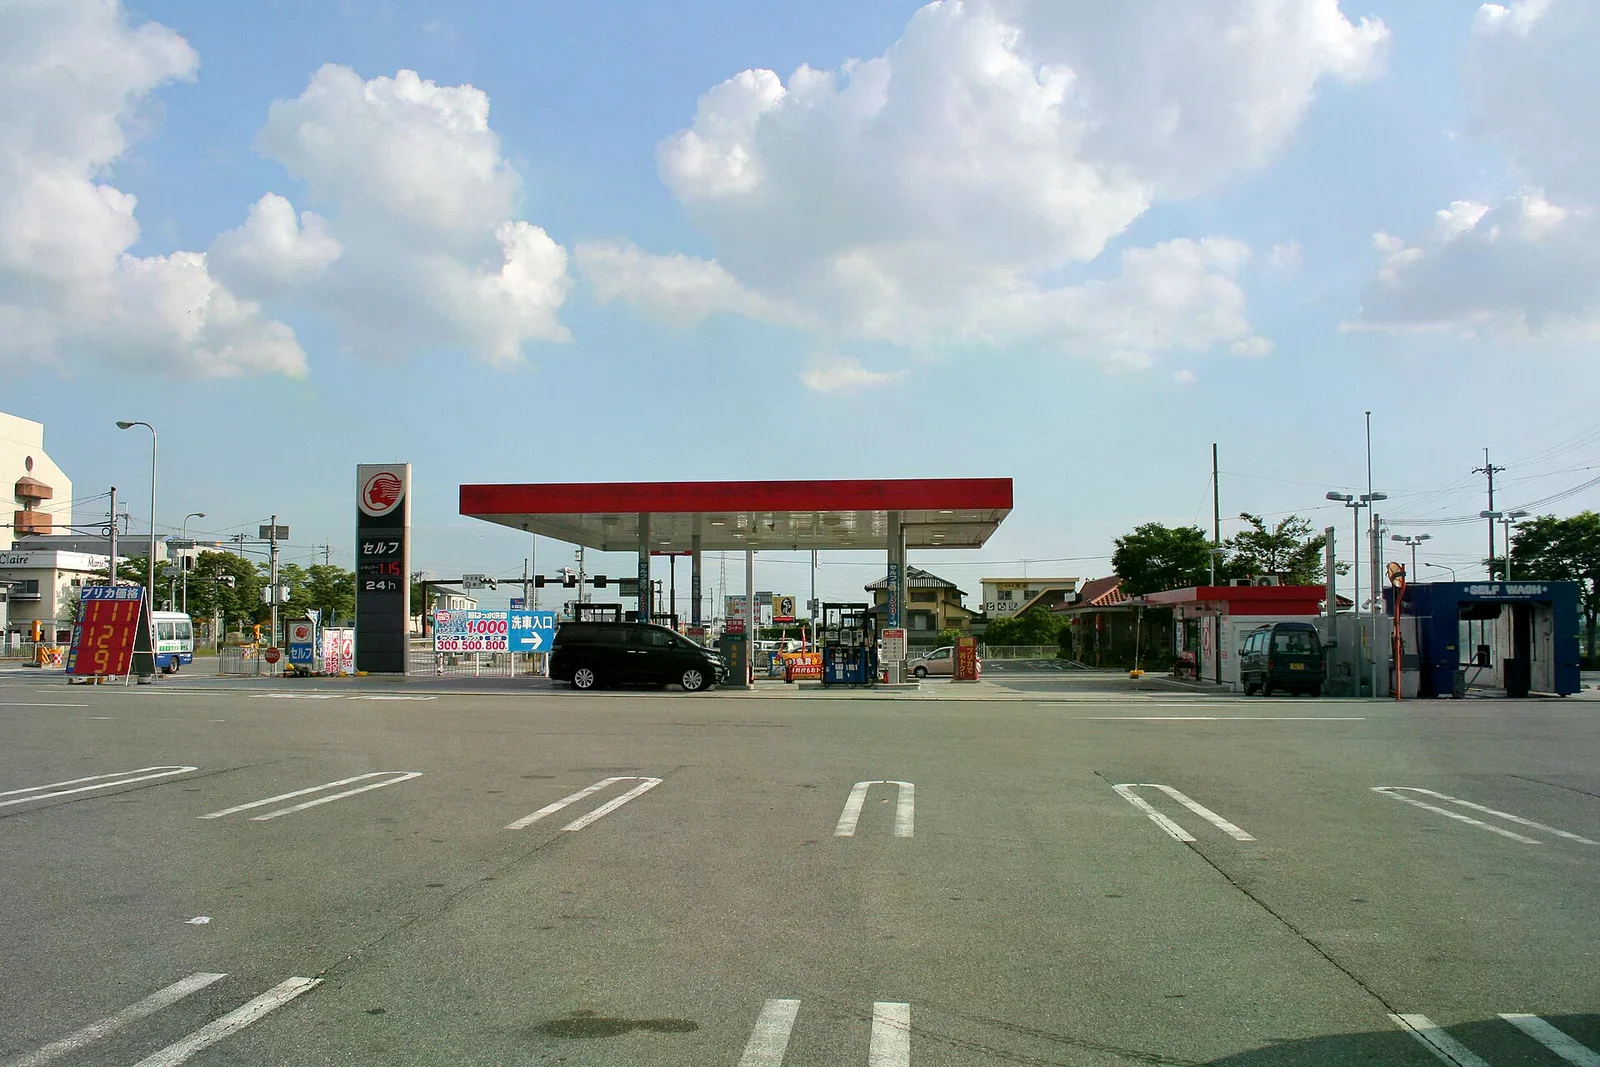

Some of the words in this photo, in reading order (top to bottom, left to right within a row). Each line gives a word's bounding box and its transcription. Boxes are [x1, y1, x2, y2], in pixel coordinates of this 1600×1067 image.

[363, 542, 399, 554] セルフ
[0, 554, 28, 564] Claire
[380, 562, 400, 575] 115
[366, 581, 396, 590] 24h
[1470, 585, 1499, 595] SELF
[1505, 585, 1542, 595] WASH
[82, 587, 139, 599] プリカ価格
[93, 601, 133, 622] 111
[512, 615, 552, 629] 洗車入口
[88, 624, 128, 649] 121
[290, 647, 312, 659] セルフ
[94, 649, 124, 674] 91
[966, 647, 974, 673] プリカで
